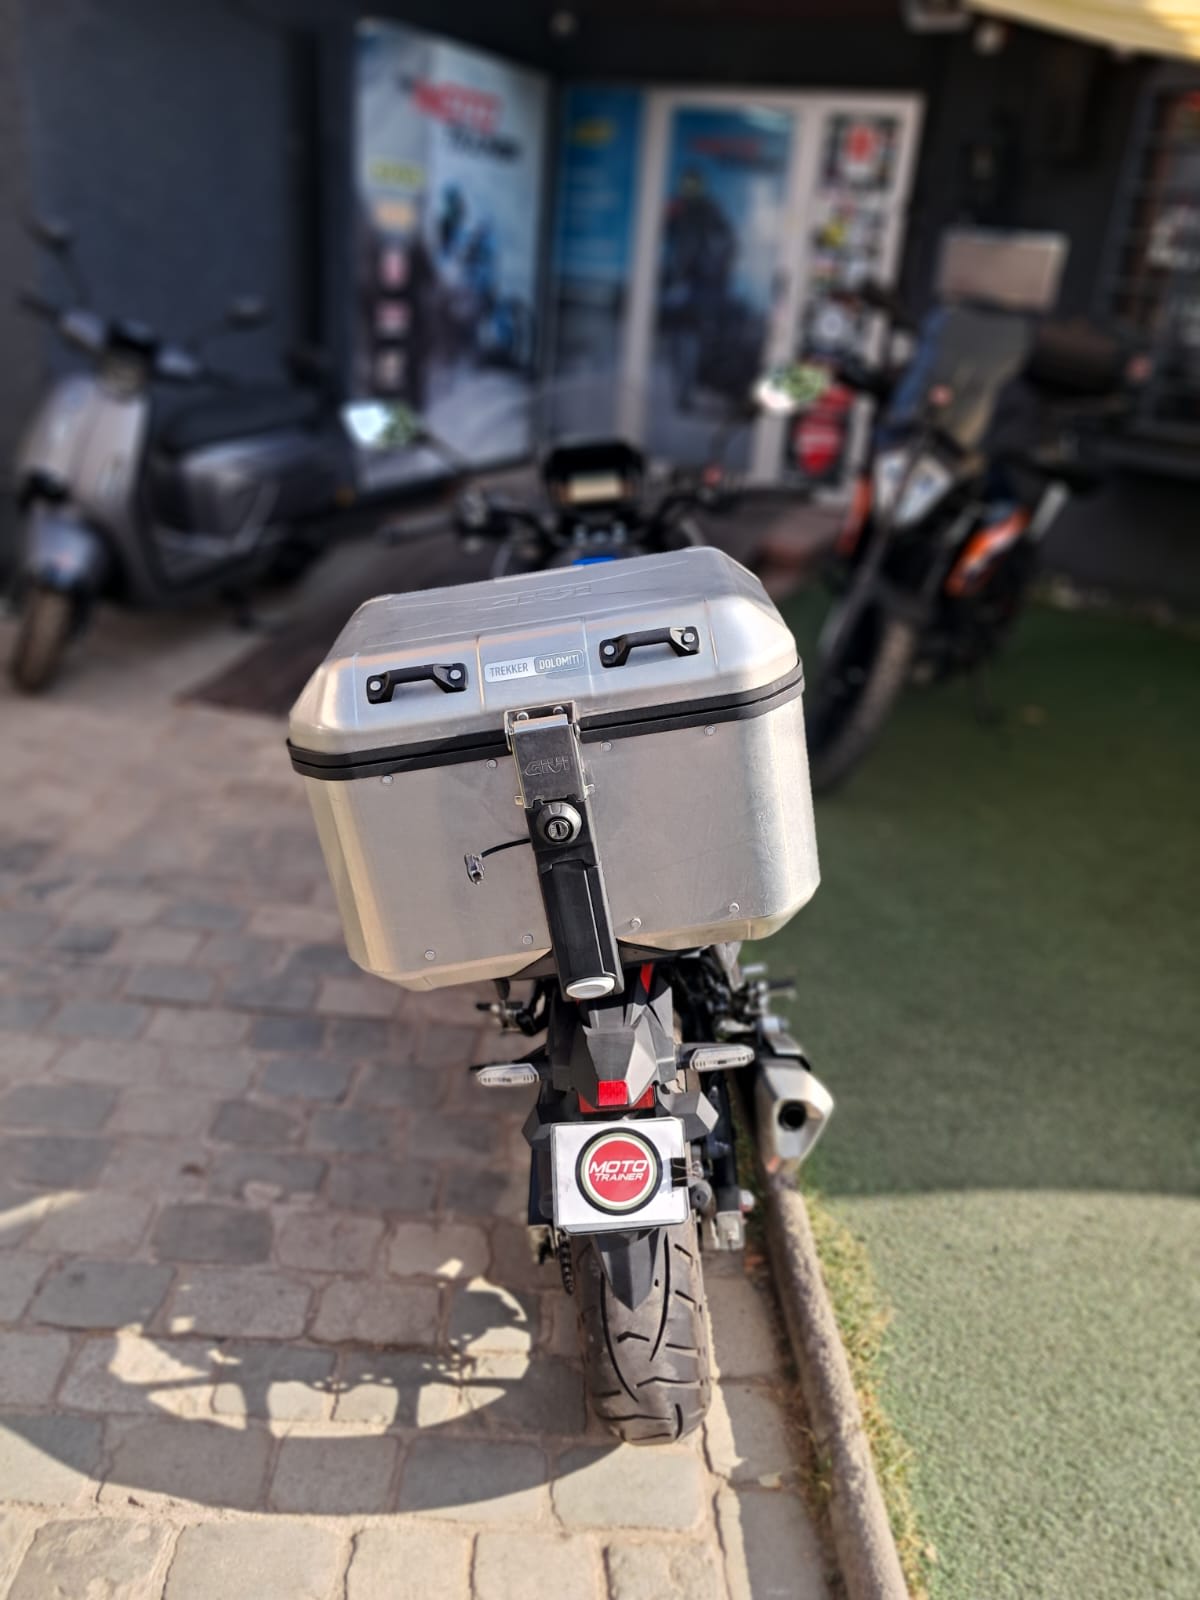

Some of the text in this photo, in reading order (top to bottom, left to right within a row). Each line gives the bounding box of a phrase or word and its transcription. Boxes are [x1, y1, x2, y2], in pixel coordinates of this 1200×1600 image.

[490, 654, 580, 677] TREKKER DOLOMITI
[589, 1159, 648, 1174] MOTO
[594, 1172, 644, 1182] TRAINER
